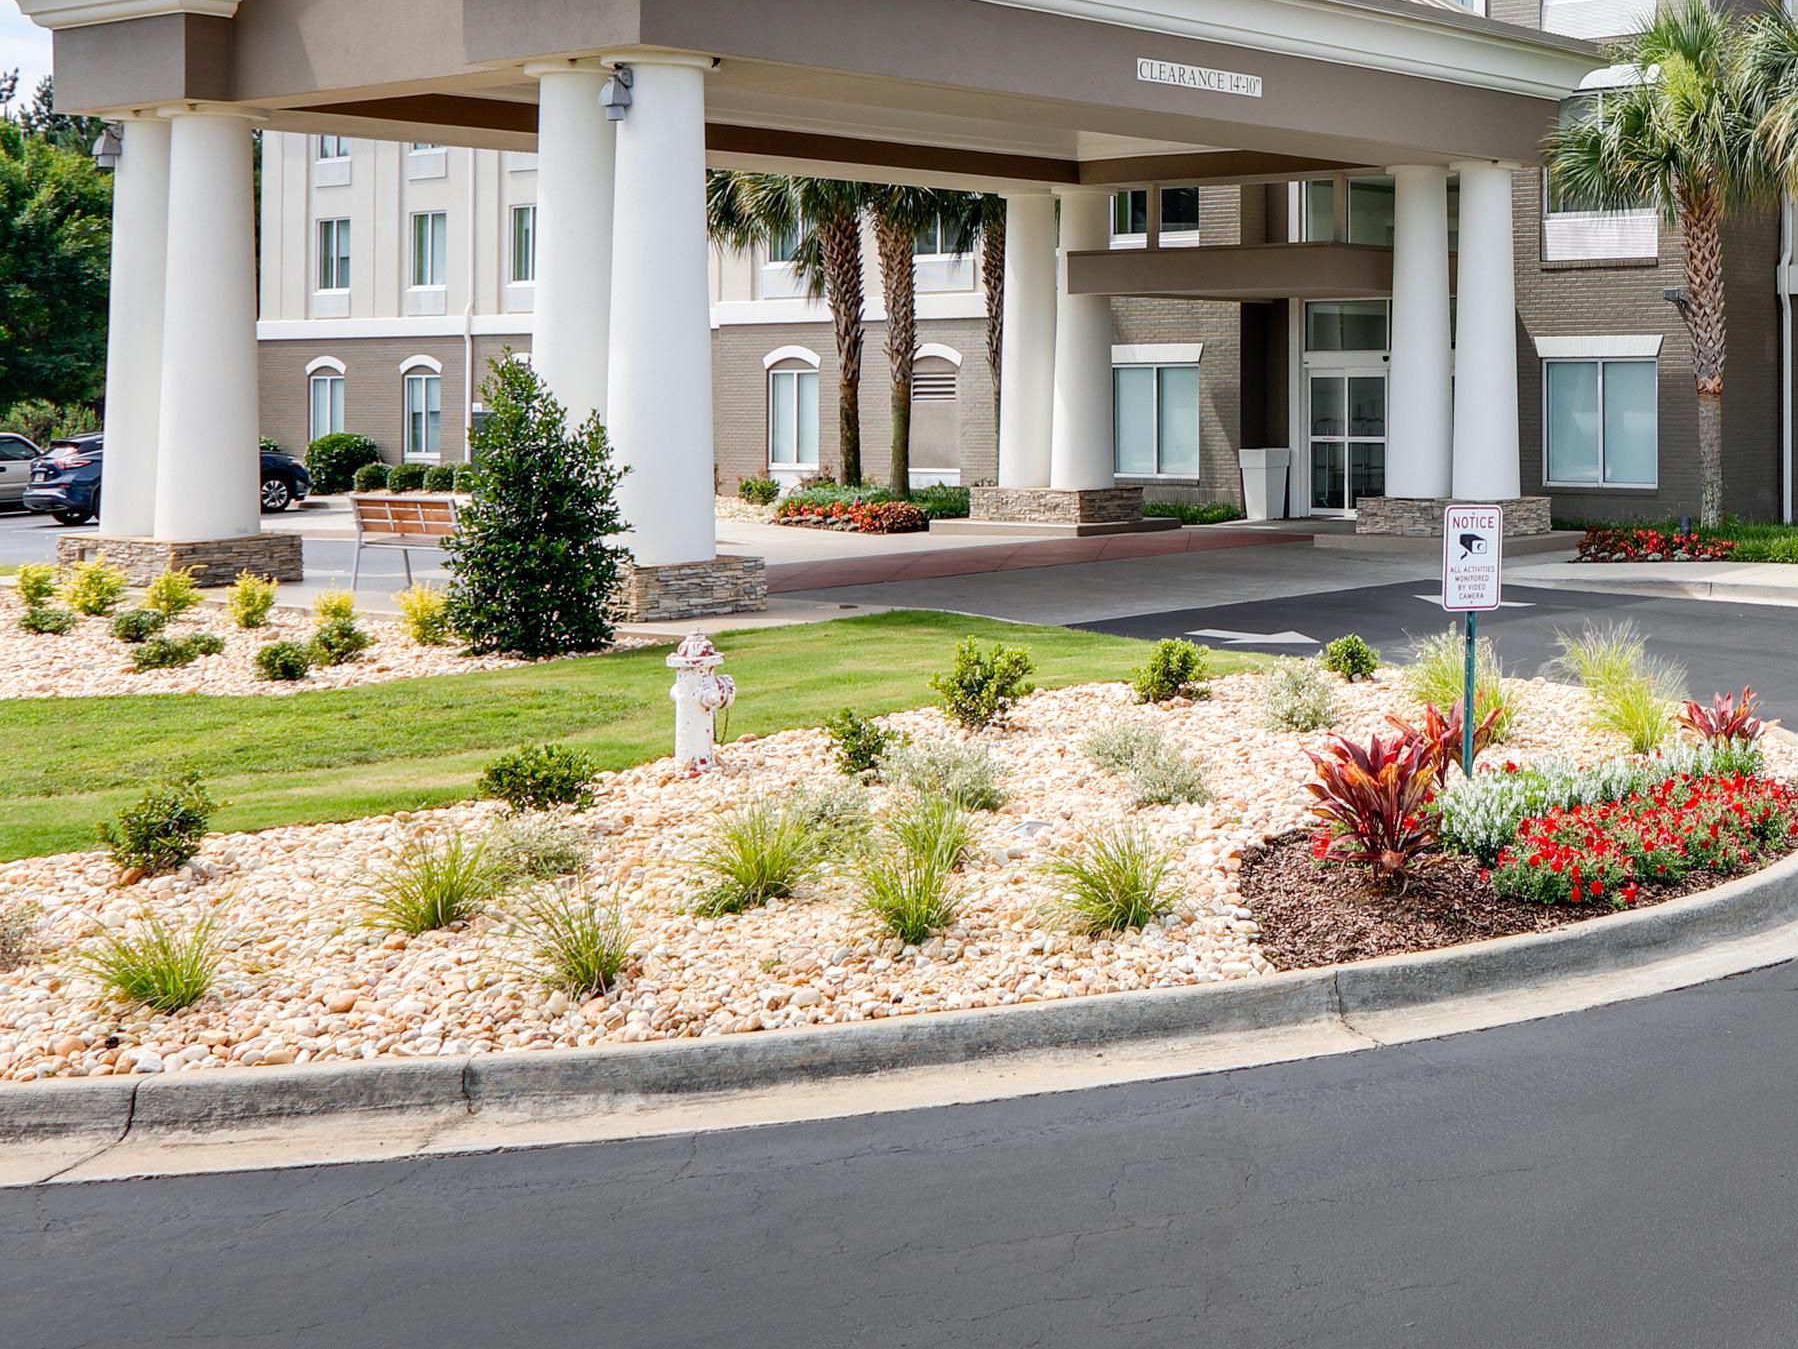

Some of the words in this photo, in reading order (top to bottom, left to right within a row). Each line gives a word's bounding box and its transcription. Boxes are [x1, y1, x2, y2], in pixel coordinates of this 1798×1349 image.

[1139, 60, 1225, 90] CLEARANCE
[1452, 516, 1494, 529] NOTICE
[1463, 565, 1496, 573] ACTIVITIES
[1455, 574, 1489, 582] MONITORED
[1468, 583, 1486, 591] VIDEO
[1459, 592, 1484, 600] CAMERA
